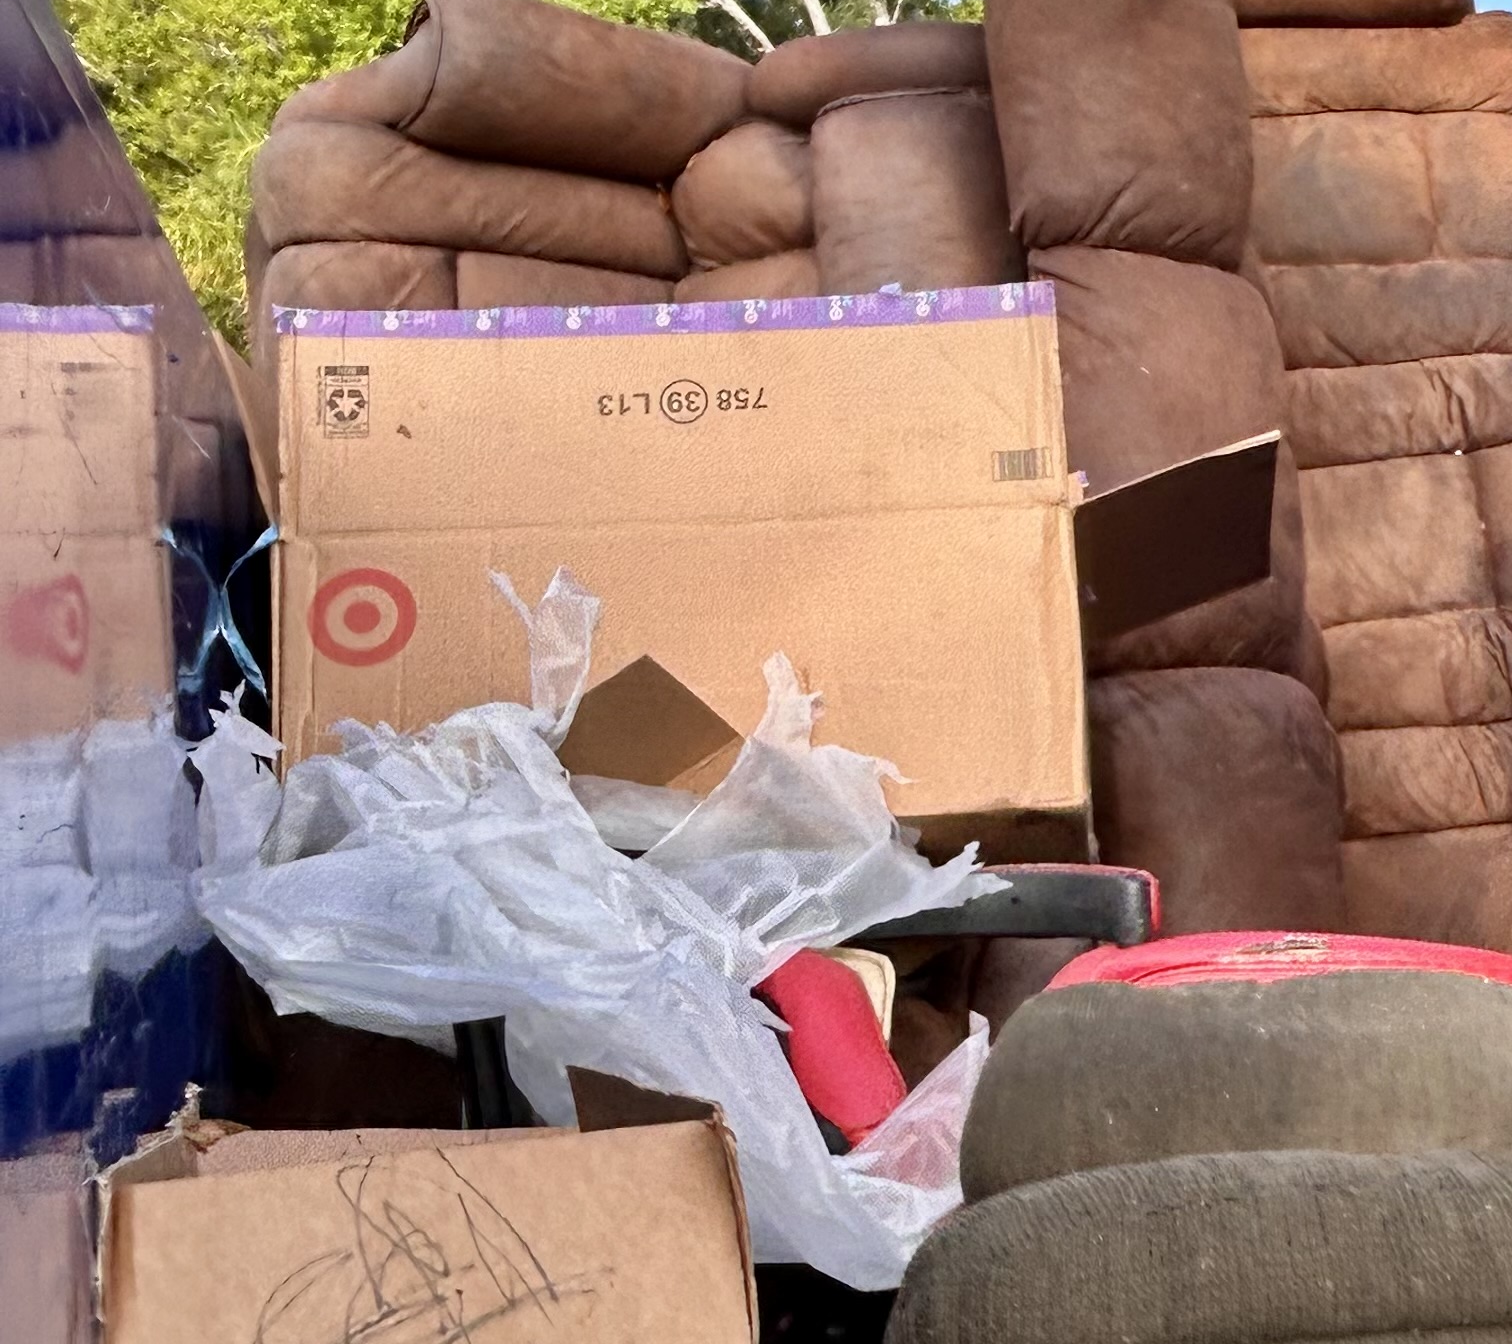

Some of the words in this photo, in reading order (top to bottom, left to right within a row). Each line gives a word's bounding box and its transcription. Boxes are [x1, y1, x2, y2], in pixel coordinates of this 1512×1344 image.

[598, 393, 650, 416] L13
[667, 391, 701, 413] 39
[716, 387, 768, 411] 758
